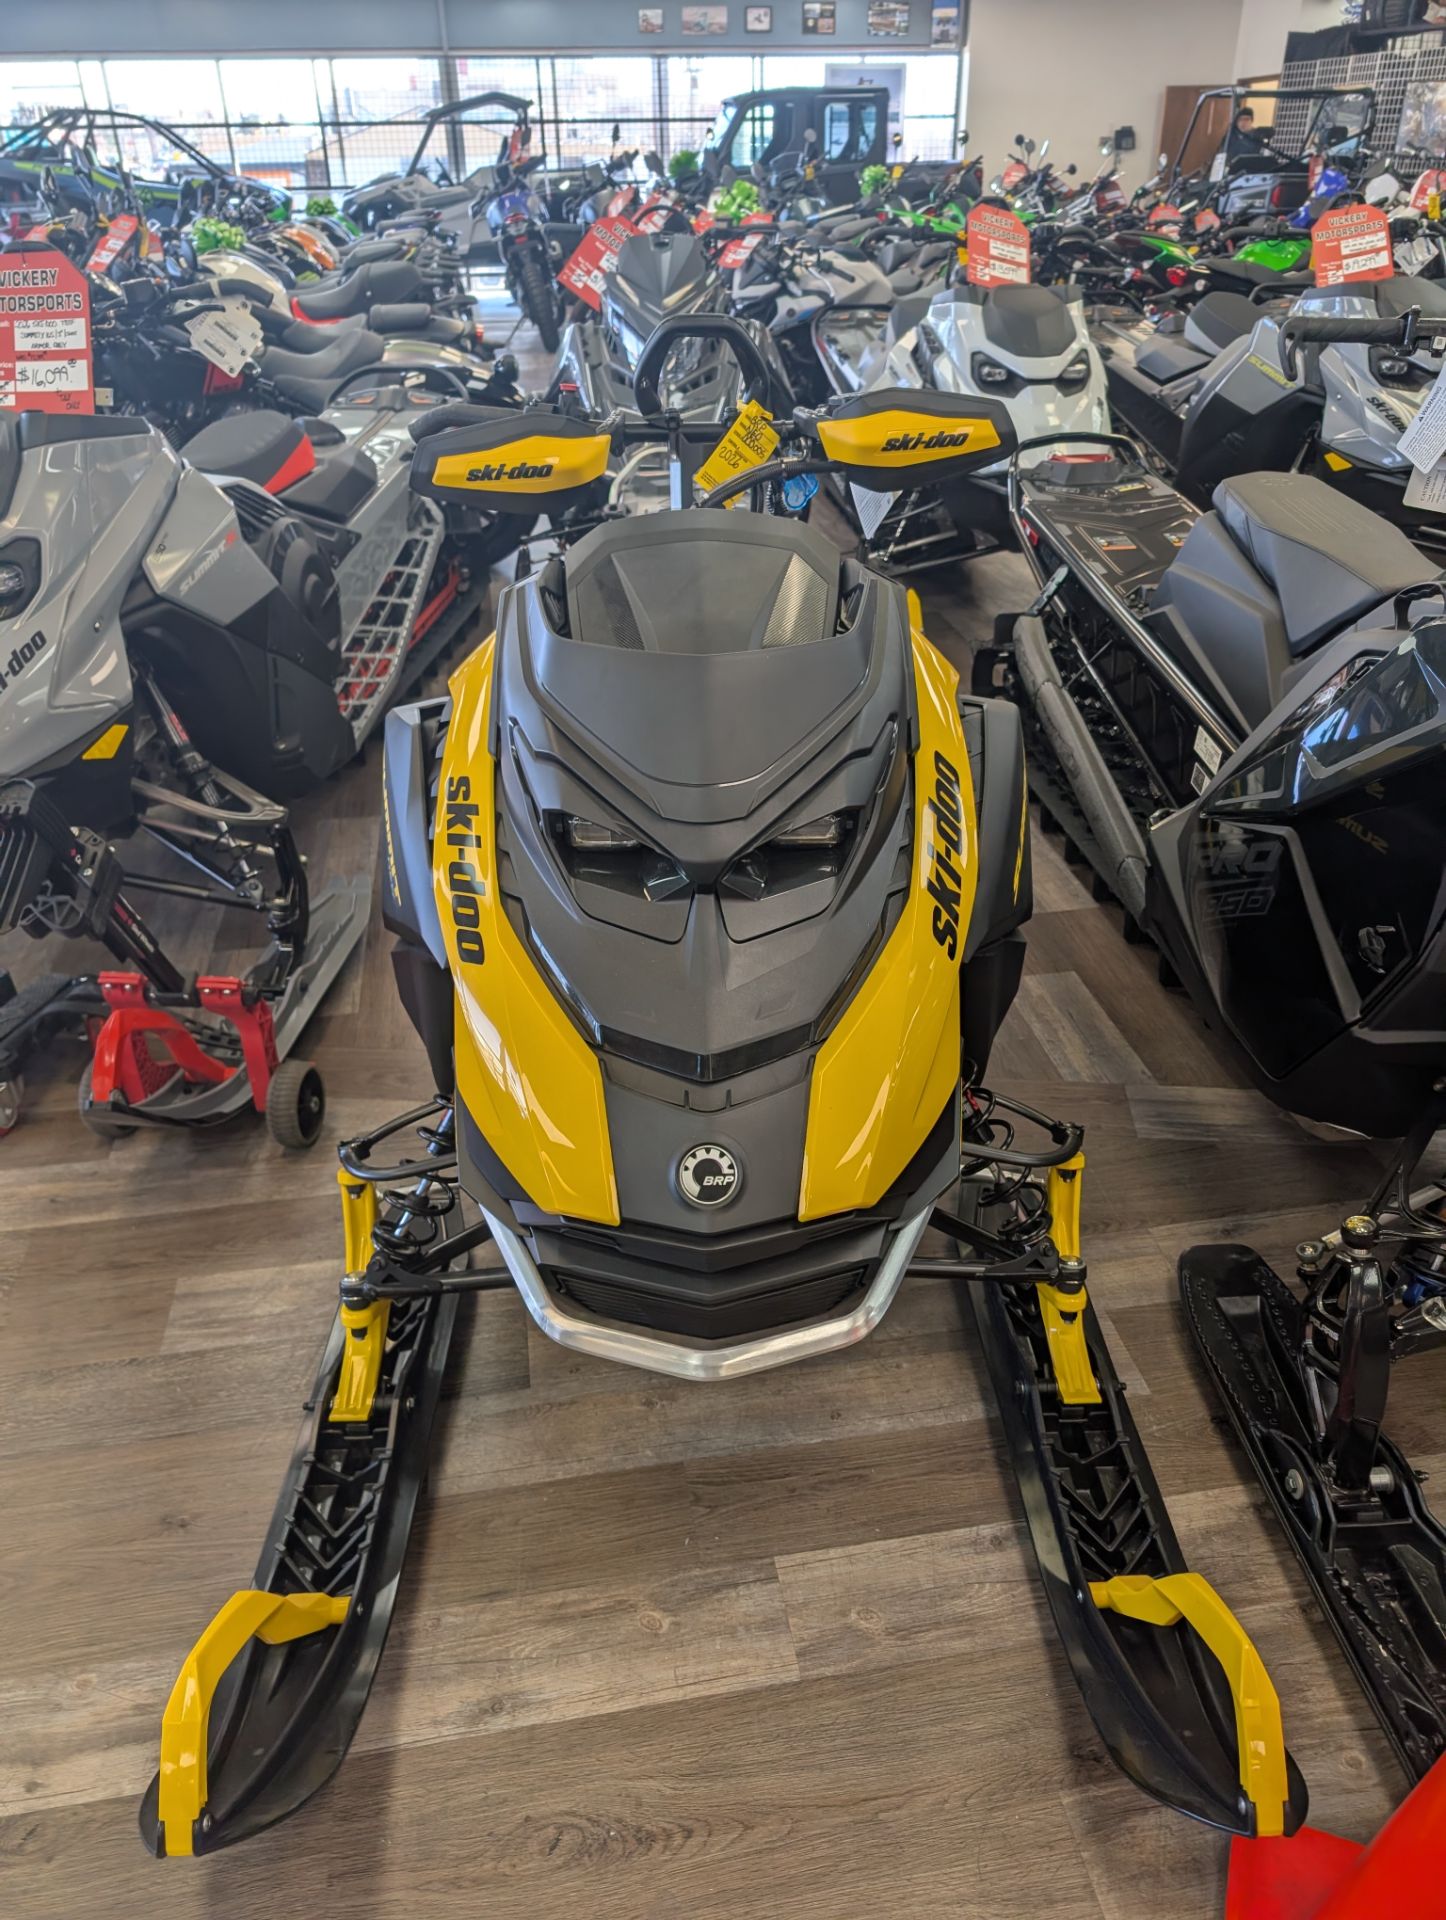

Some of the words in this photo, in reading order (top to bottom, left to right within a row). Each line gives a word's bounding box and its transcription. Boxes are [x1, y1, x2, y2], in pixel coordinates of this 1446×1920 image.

[983, 213, 1014, 230] VICKERY
[1315, 220, 1385, 241] MOTORSPORTS
[1329, 212, 1368, 227] VICKERY
[971, 221, 1025, 246] MOTORSPORTS
[1421, 385, 1442, 417] WARNING
[881, 430, 969, 452] ski-doo
[718, 446, 740, 469] 2026
[466, 462, 554, 482] ski-doo
[927, 750, 962, 961] ski-doo
[446, 775, 486, 966] ski-doo
[702, 1175, 735, 1187] BRP
